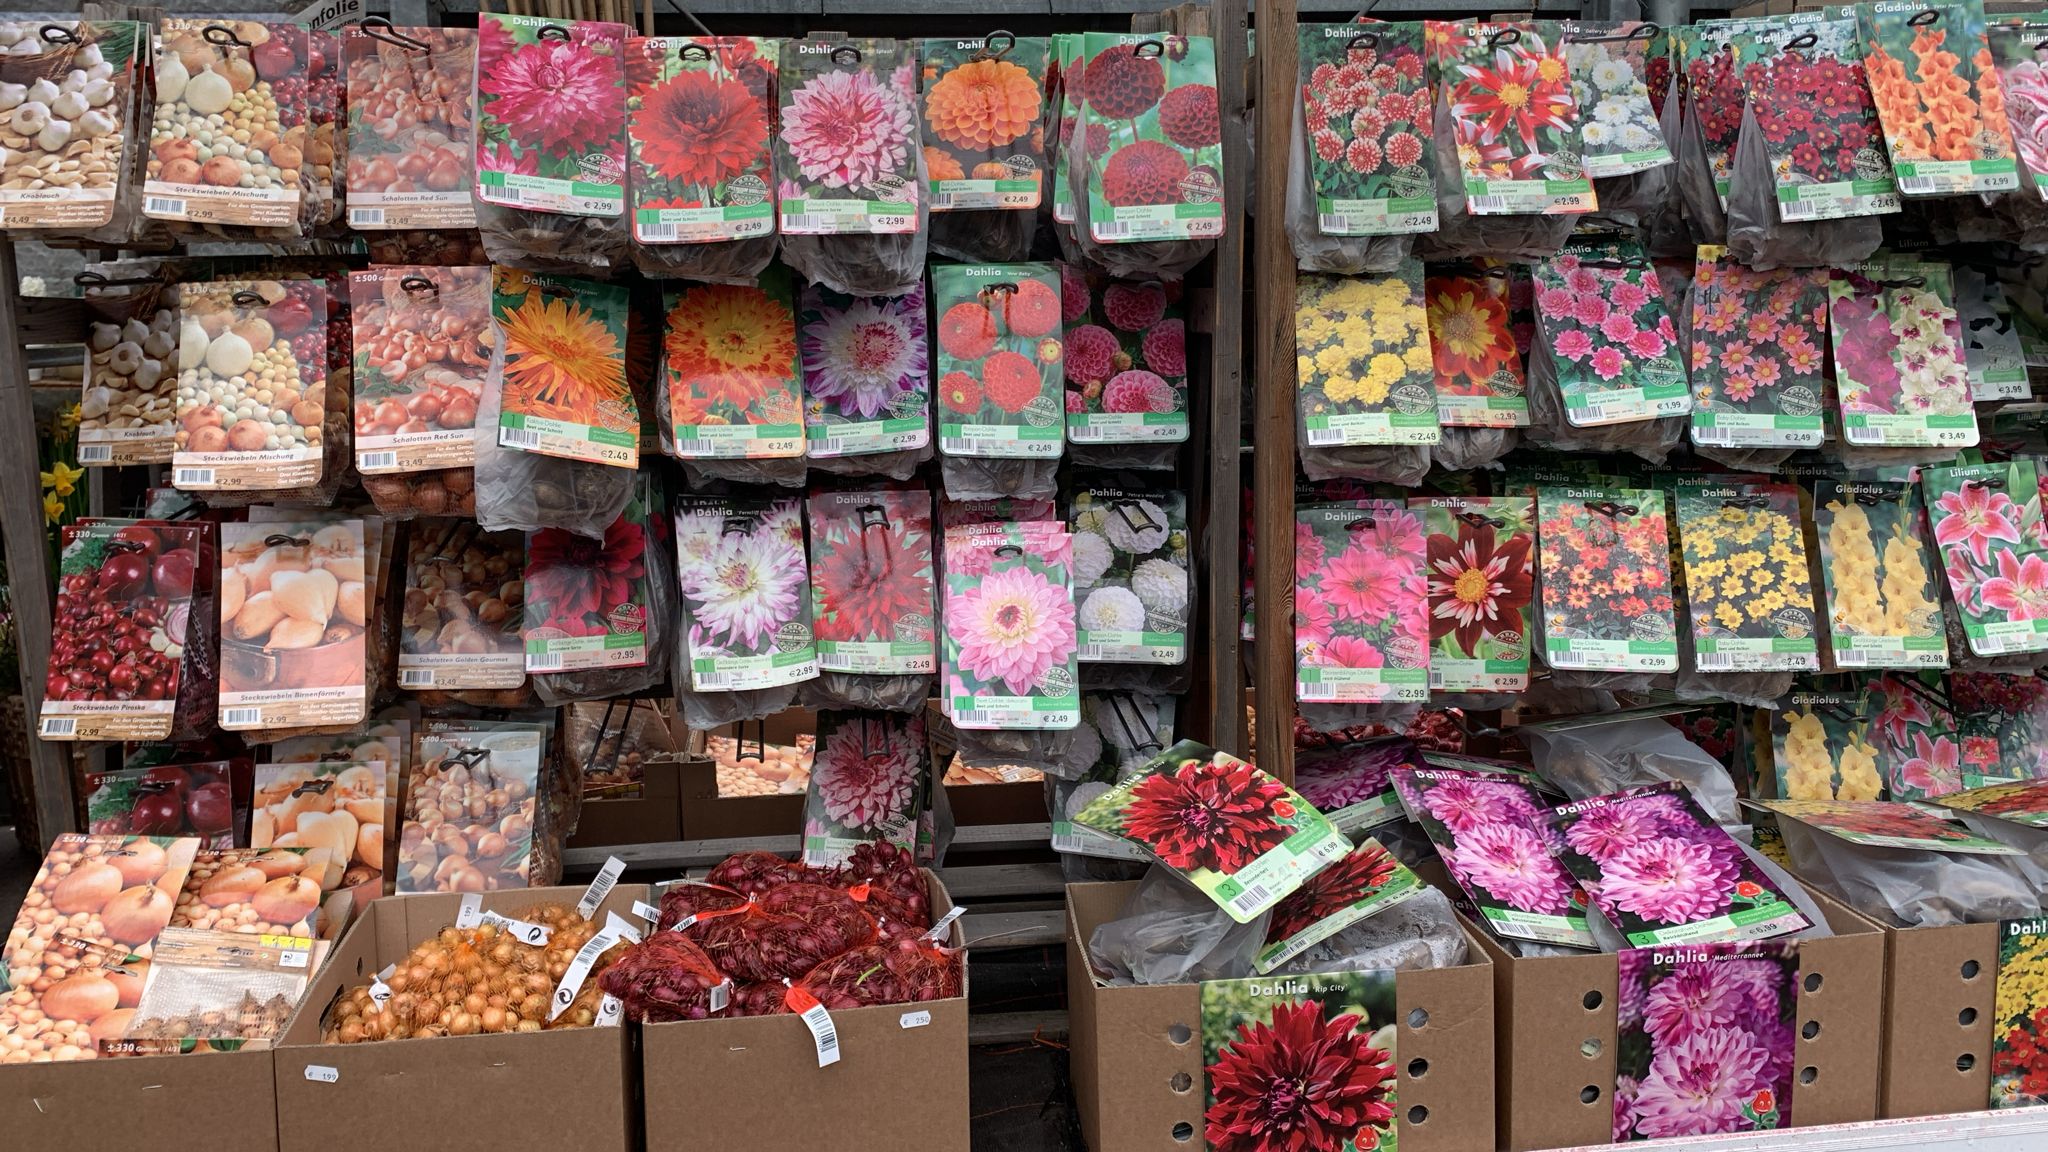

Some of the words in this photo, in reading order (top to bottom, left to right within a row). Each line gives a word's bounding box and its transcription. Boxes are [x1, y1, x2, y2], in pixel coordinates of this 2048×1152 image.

[1874, 2, 1928, 13] Gladiolus
[1789, 14, 1824, 25] Gladio
[1561, 23, 1580, 33] hlia
[651, 40, 688, 49] Dahli
[1119, 35, 1150, 45] Dahli
[20, 192, 60, 200] Knoblauch
[231, 190, 269, 200] Mischung
[381, 194, 418, 202] Schalotten
[966, 268, 1001, 276] Dahlia
[523, 274, 554, 287] Dahli
[124, 430, 156, 438] Knoblauch
[393, 434, 432, 444] Schalotten
[434, 433, 449, 441] Red
[450, 432, 464, 440] Sun
[203, 453, 257, 463] Steckzwiebeln
[258, 453, 294, 463] Mischung
[1534, 473, 1569, 482] Dahlia
[1950, 467, 1980, 478] Lilium
[1677, 478, 1711, 487] Dahlia
[1089, 488, 1123, 497] Dahlia
[1567, 489, 1603, 498] Dahlia
[1702, 488, 1737, 498] Dahlia
[1835, 484, 1884, 494] Gladiolus
[836, 495, 870, 505] Dahlia
[1431, 499, 1467, 508] Dahlia
[697, 507, 733, 517] Dahlia
[965, 503, 996, 512] Dahlia
[1325, 512, 1362, 521] Dahlia
[968, 525, 1003, 535] Dahlia
[971, 537, 1008, 547] Dahlia
[419, 656, 454, 664] Schalotten
[456, 656, 476, 664] Golden
[478, 656, 508, 664] Gourmet
[240, 692, 292, 702] Steckzwiebeln
[1792, 695, 1840, 705] Gladiolus
[72, 703, 118, 711] Steckzwiebeln
[120, 703, 145, 711] Piroska
[1415, 769, 1460, 781] Dahlia
[1103, 773, 1142, 802] Dahlia
[1555, 798, 1606, 816] Dahlia
[1222, 883, 1236, 896] 3
[2010, 921, 2048, 936] Dahl
[1637, 934, 1649, 944] 3
[1653, 951, 1708, 966] Dahlia
[1711, 951, 1767, 963] 'Mediterrannee'
[1250, 981, 1308, 997] Dahlia
[1330, 983, 1348, 993] City'
[916, 1016, 929, 1024] 250
[107, 1043, 134, 1052] ±330
[323, 1073, 336, 1081] 199
